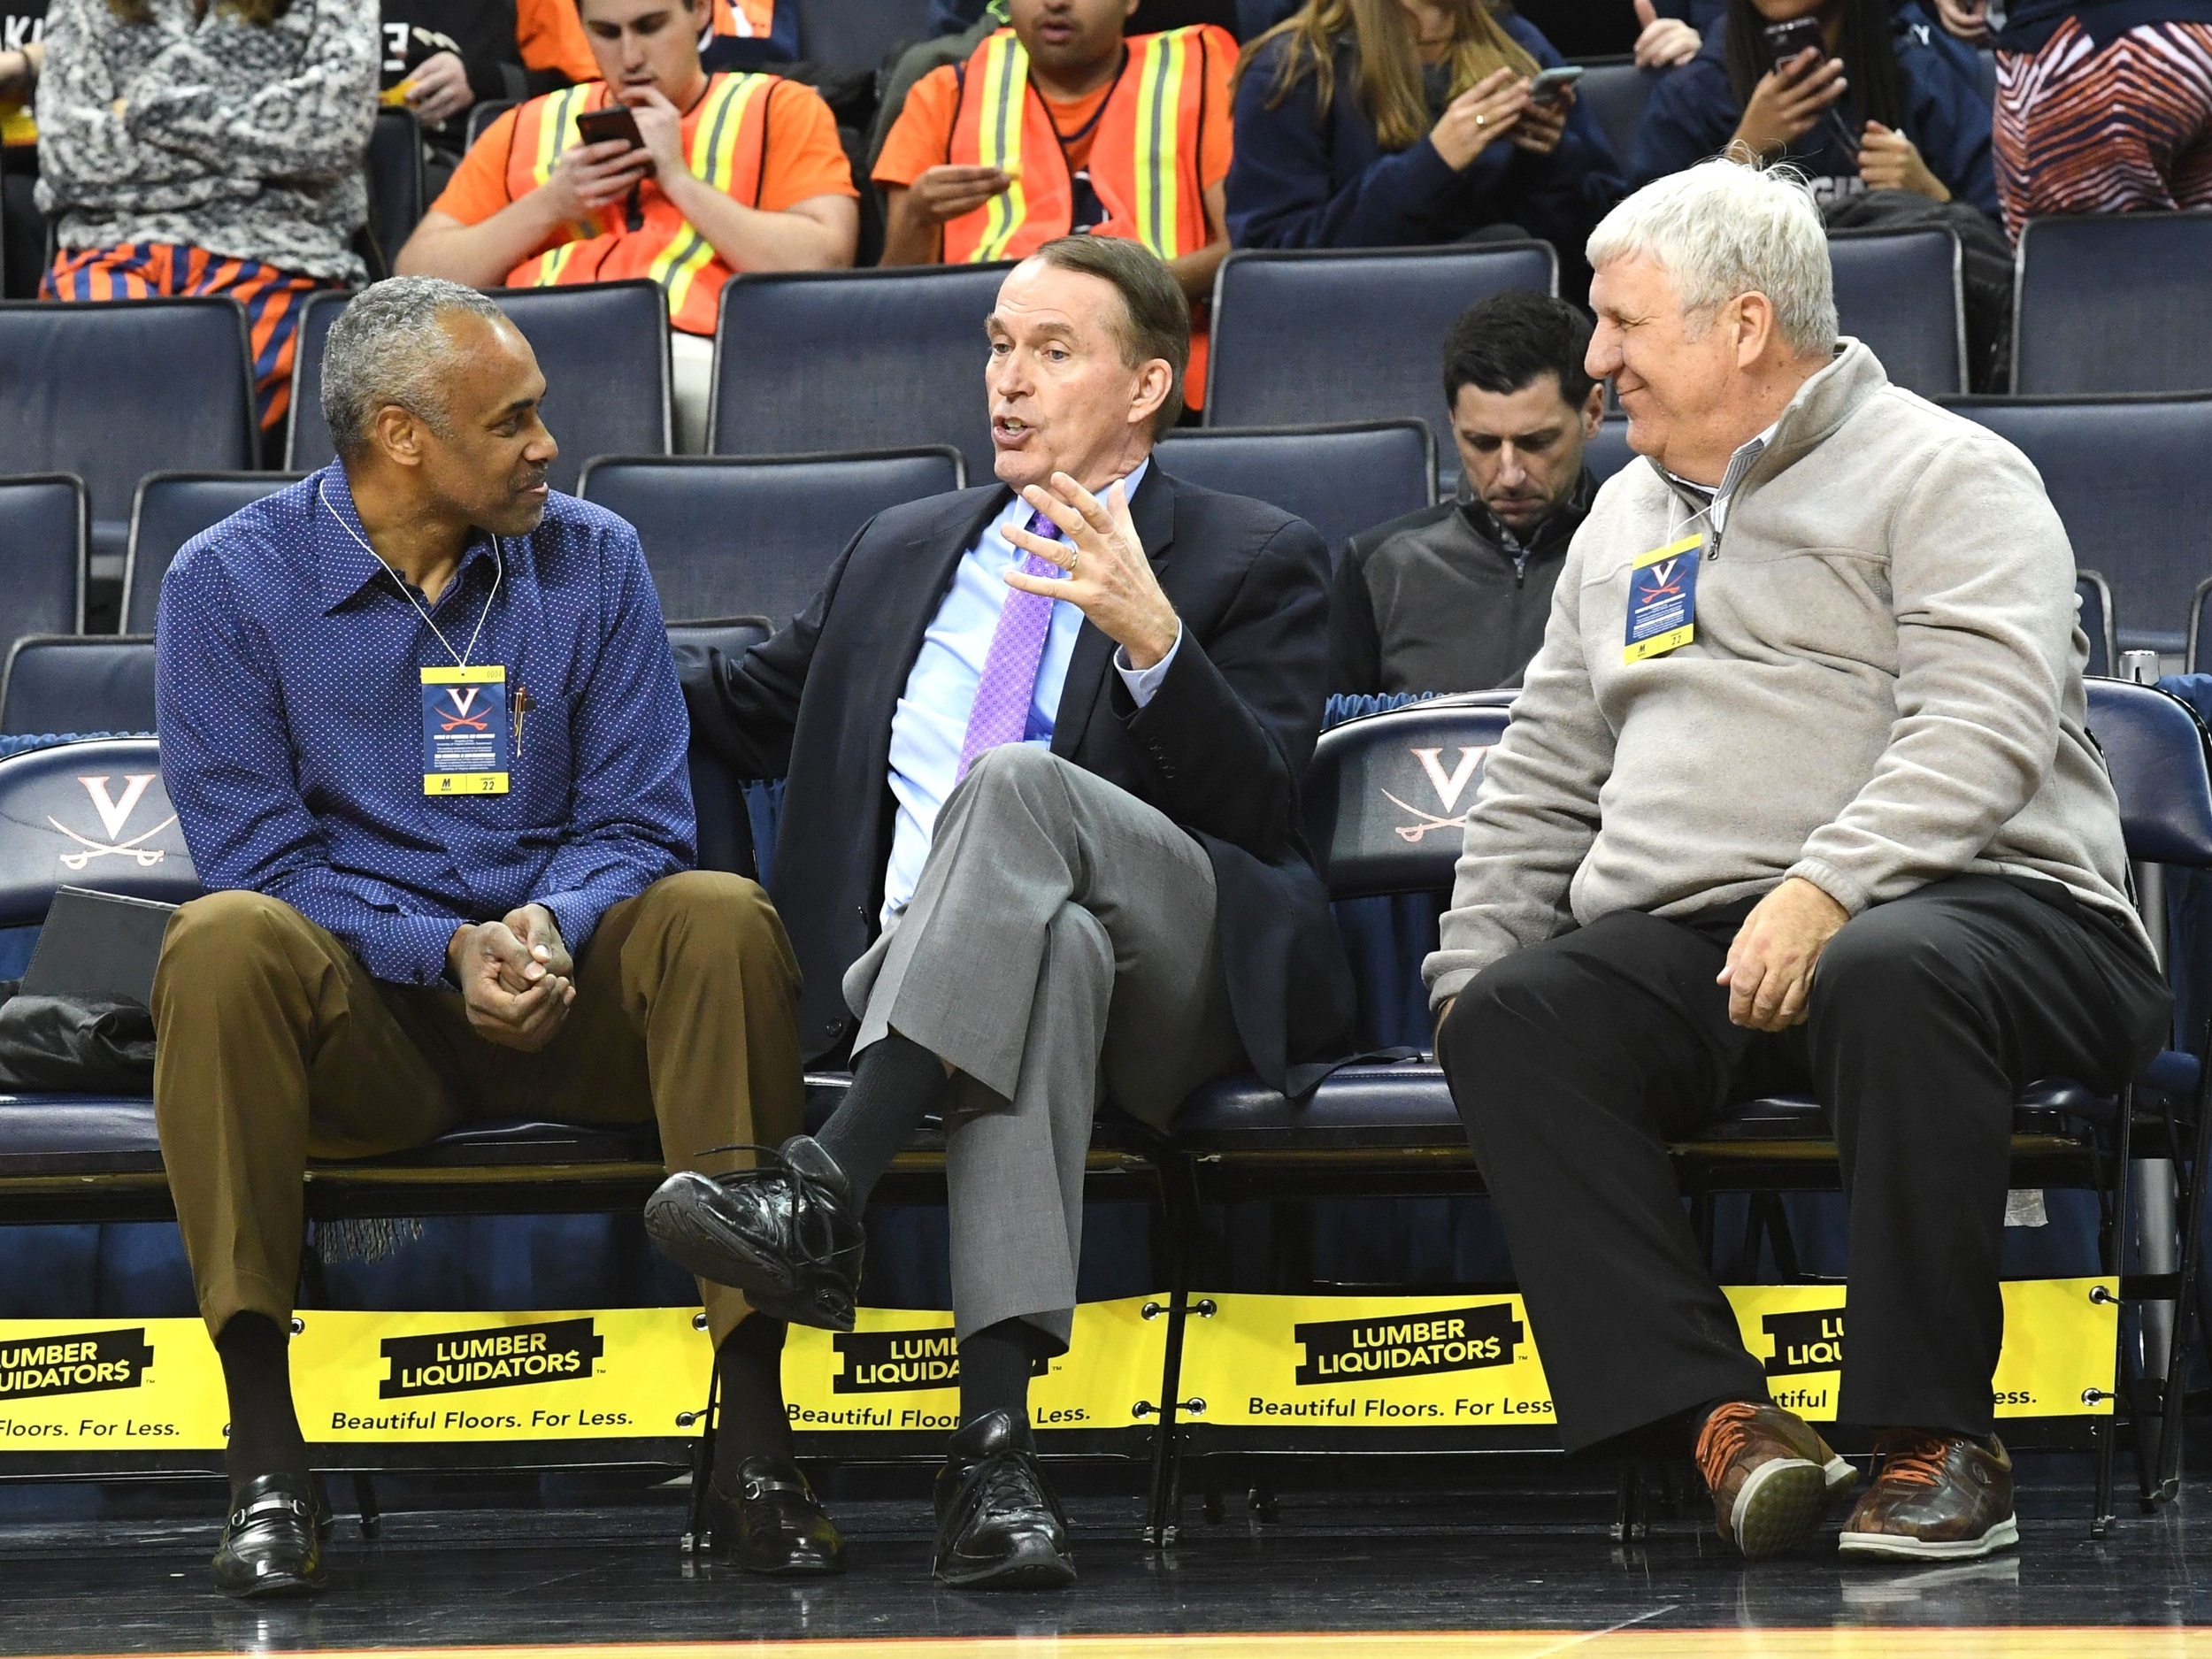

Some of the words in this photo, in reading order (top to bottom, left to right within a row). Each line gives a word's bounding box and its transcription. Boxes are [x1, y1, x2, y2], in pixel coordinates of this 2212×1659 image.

[445, 687, 480, 719] V
[442, 778, 451, 787] M
[482, 780, 495, 791] 22
[1409, 745, 1490, 814] V
[77, 773, 157, 841] V
[1352, 1318, 1465, 1348] LUMBER
[0, 1341, 98, 1370] UMBER
[436, 1333, 548, 1363] LUMBER
[1318, 1336, 1502, 1375] LIQUIDATOR$
[402, 1349, 581, 1388] LIQUIDATOR$
[1248, 1397, 1356, 1417] Beautiful
[1364, 1399, 1445, 1417] Floors.
[1455, 1399, 1494, 1416] For
[1773, 1389, 1826, 1408] tiful
[79, 1419, 119, 1436] For
[126, 1418, 180, 1436] Less.
[331, 1411, 436, 1430] Beautiful
[444, 1410, 522, 1429] Floors.
[531, 1410, 571, 1427] For
[578, 1409, 634, 1426] Less.
[787, 1403, 892, 1427] Beautiful
[1036, 1406, 1091, 1425] Less.
